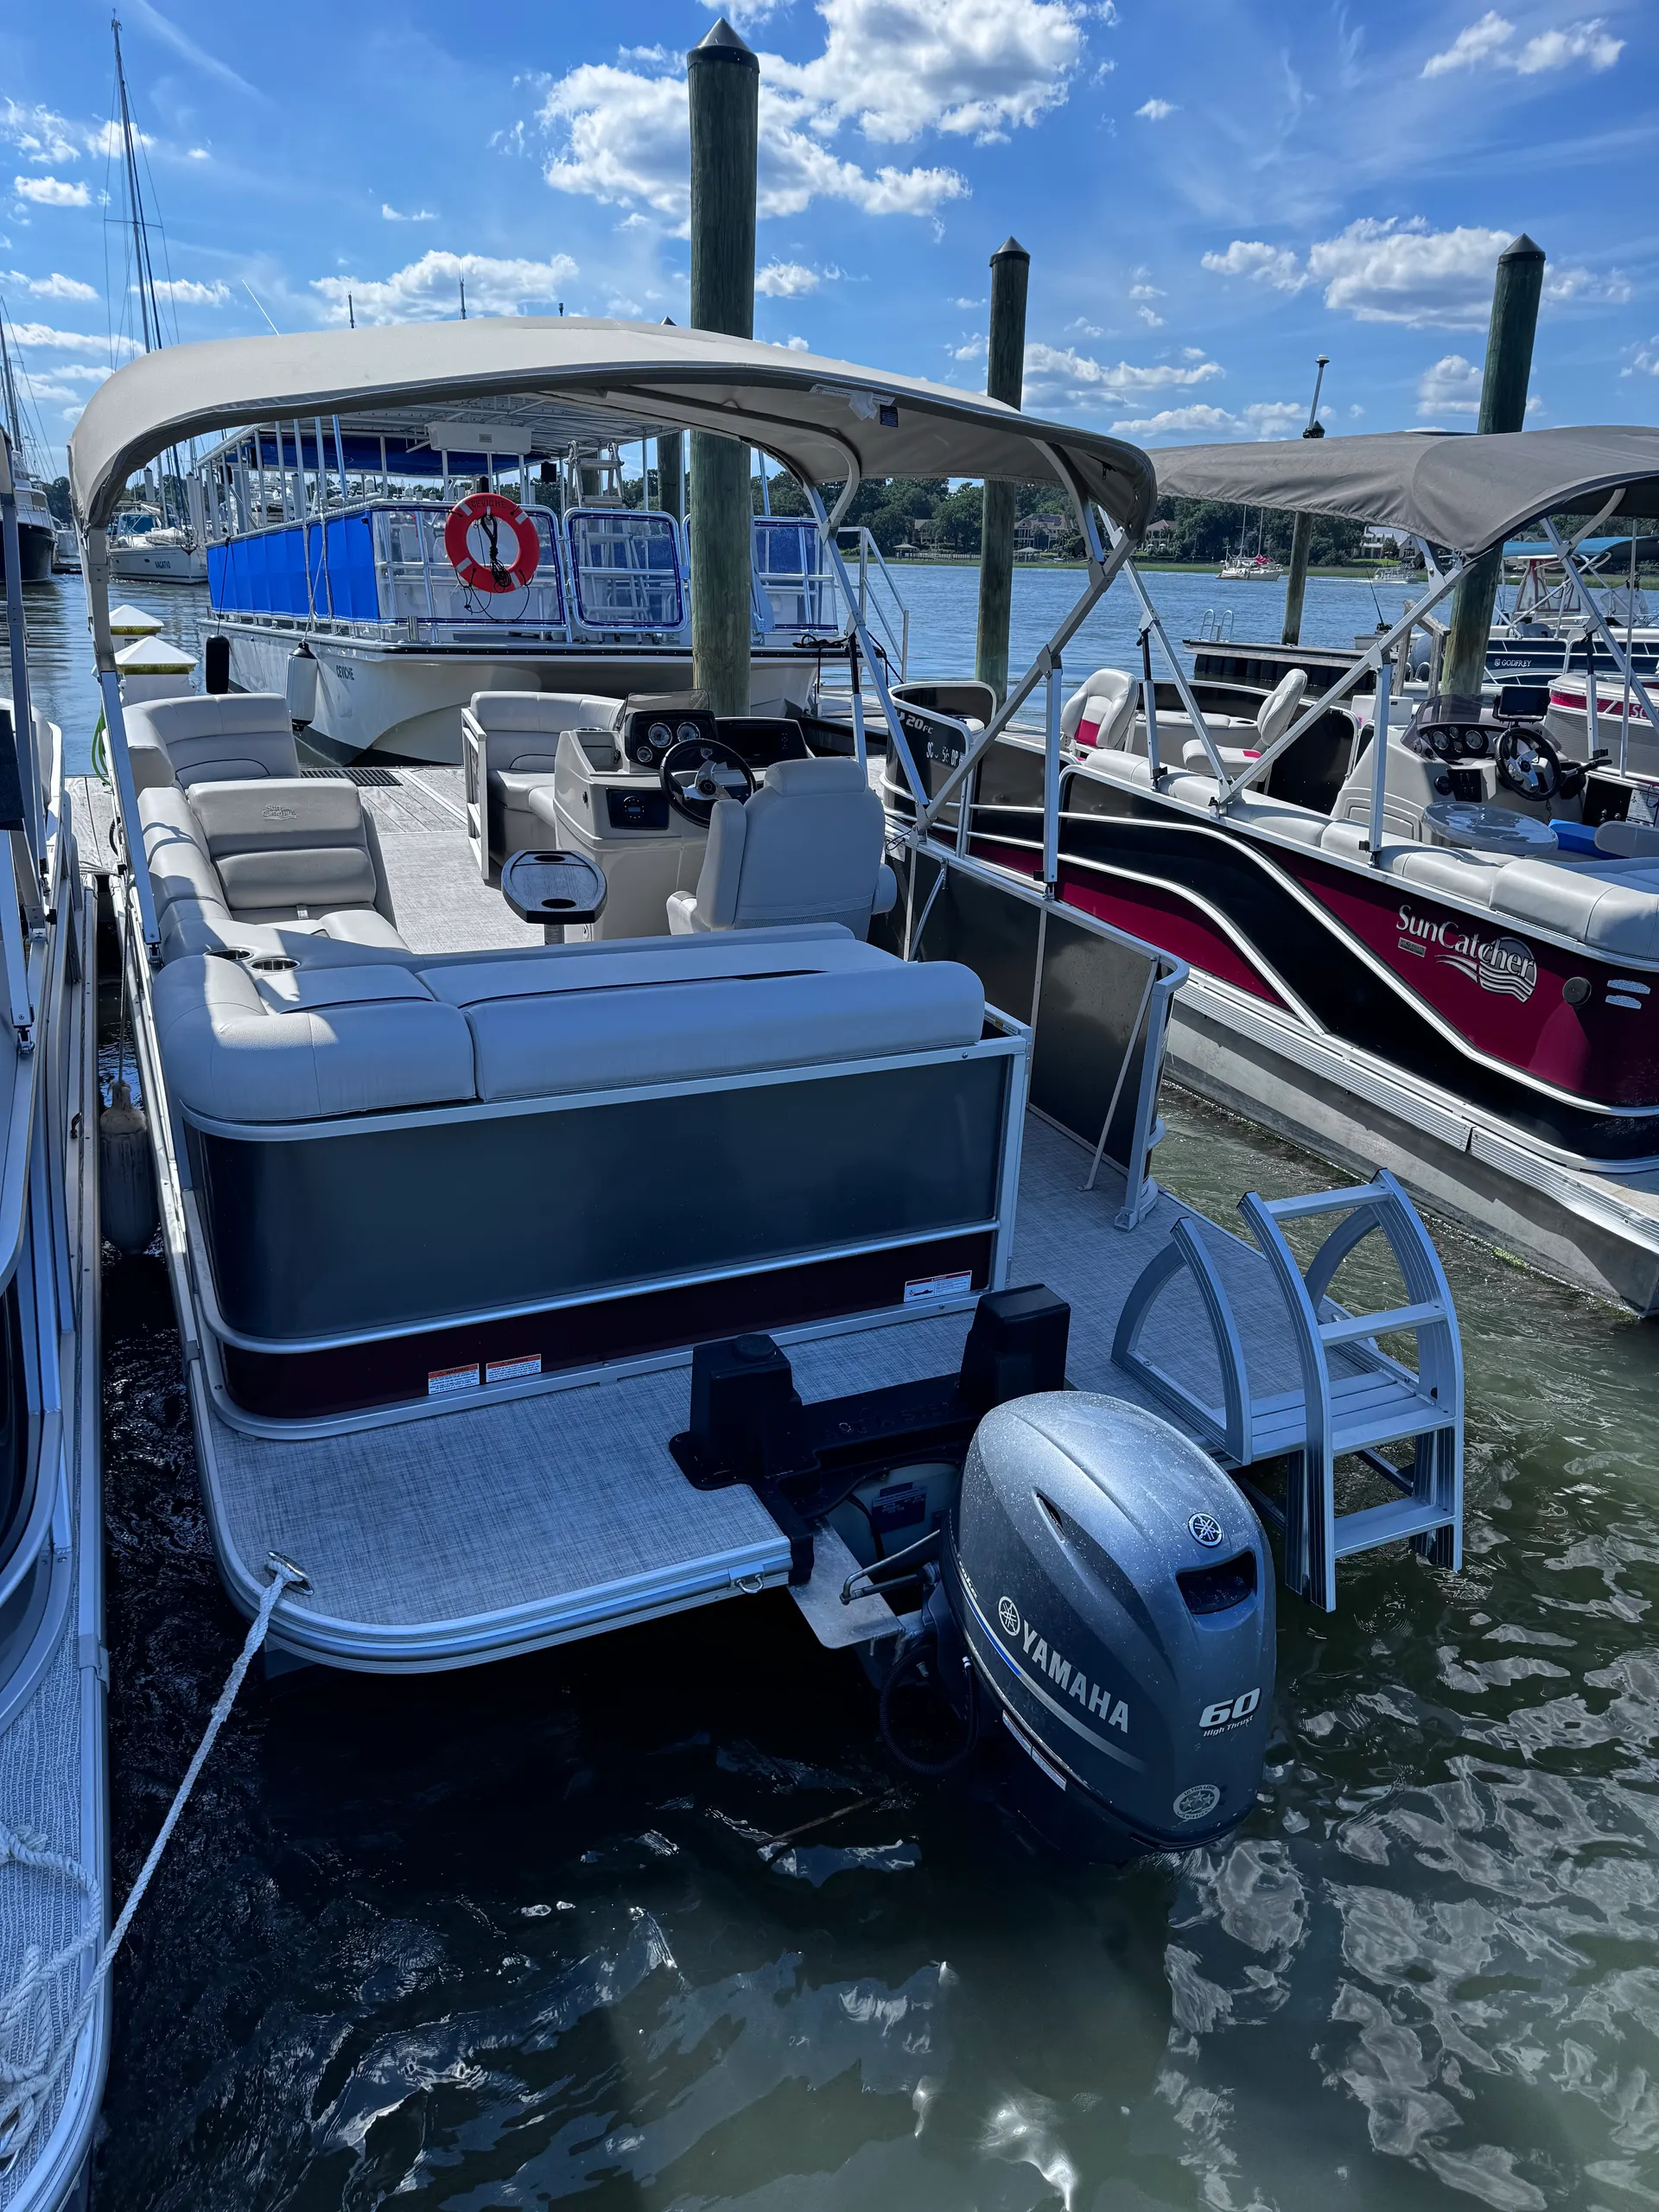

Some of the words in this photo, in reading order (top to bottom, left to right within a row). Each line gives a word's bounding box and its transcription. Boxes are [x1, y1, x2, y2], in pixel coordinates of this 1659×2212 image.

[471, 499, 506, 508] CEVICHE
[1501, 658, 1532, 667] GODFREY
[1395, 905, 1535, 979] SunCatcher
[1022, 1620, 1128, 1733] YAMAHA
[1198, 1687, 1261, 1727] 60
[1203, 1727, 1224, 1738] High
[1227, 1715, 1254, 1731] Thrust
